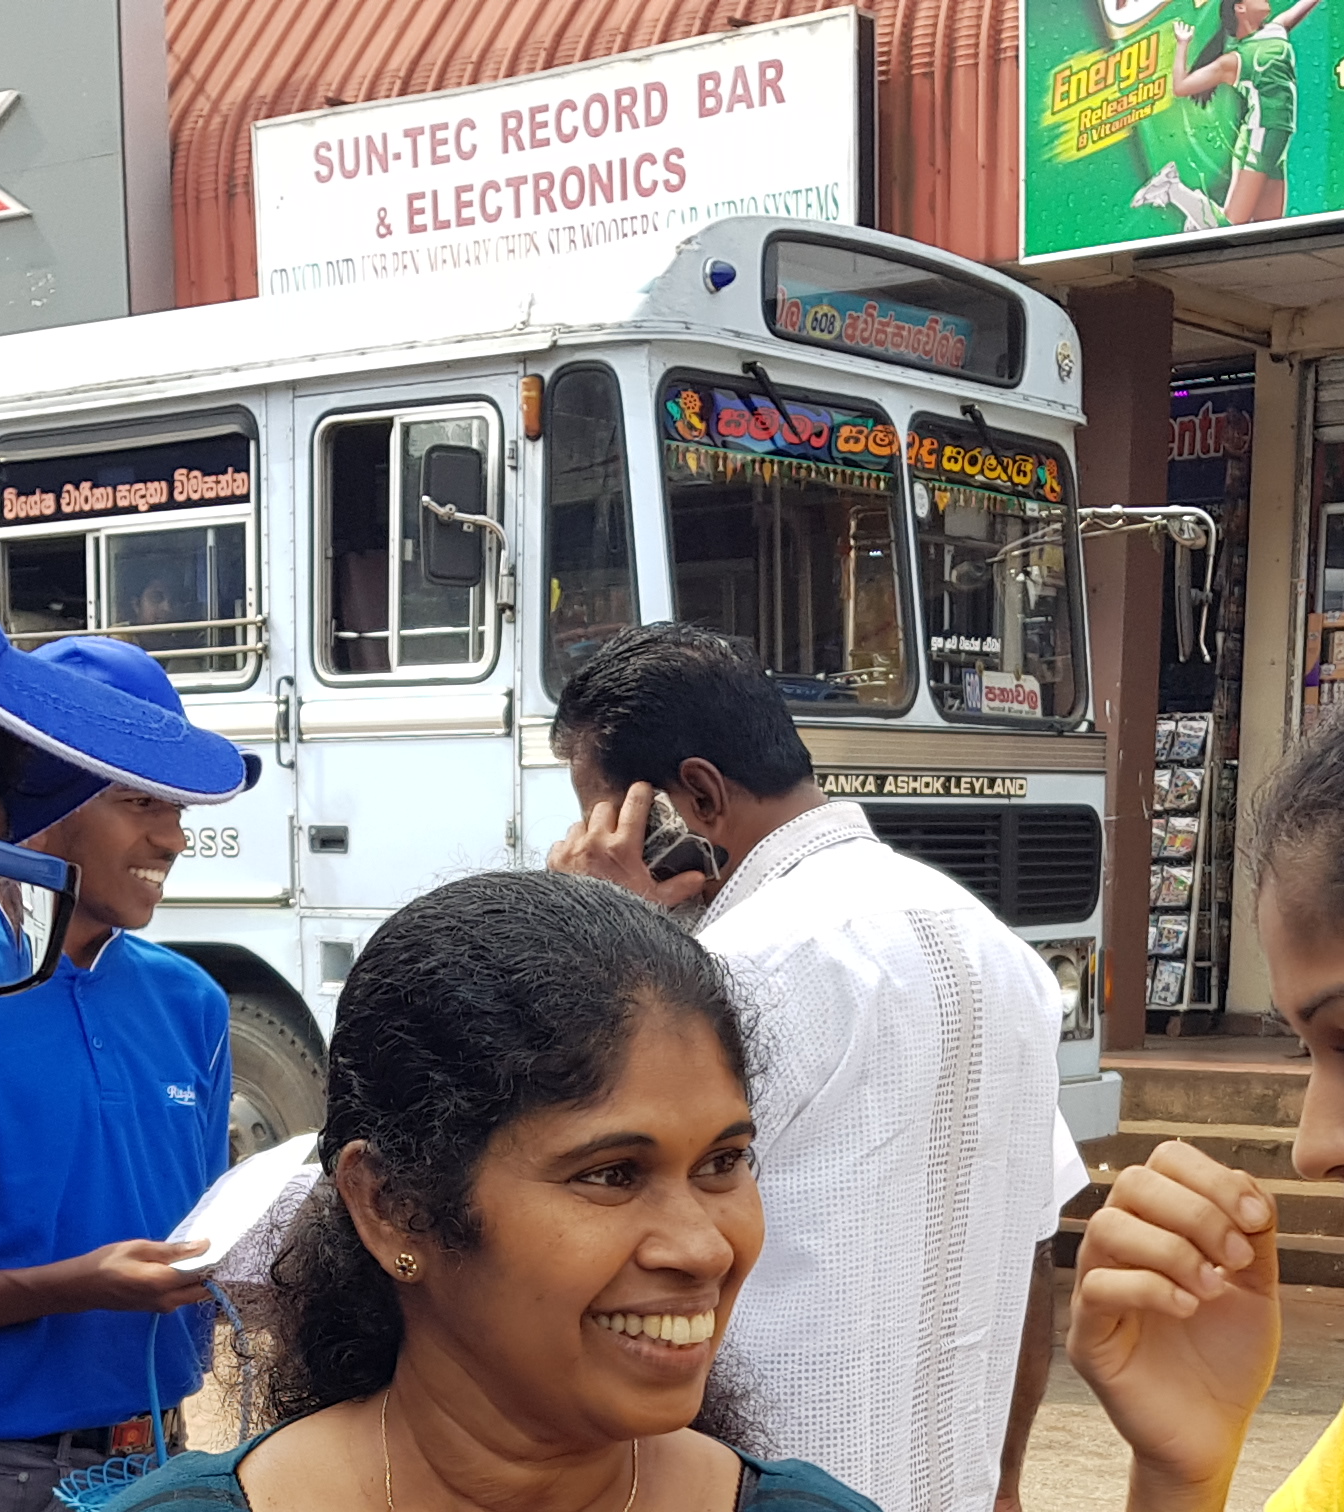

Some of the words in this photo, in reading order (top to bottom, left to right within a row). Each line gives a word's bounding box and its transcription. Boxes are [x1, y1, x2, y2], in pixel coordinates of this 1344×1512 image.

[1051, 32, 1160, 115] Energy
[1079, 74, 1168, 131] Releasing
[313, 118, 478, 185] SUN-TEC
[500, 80, 669, 155] RECORD
[697, 58, 787, 119] BAR
[1091, 103, 1155, 143] Vitamins
[375, 205, 394, 239] &
[406, 147, 687, 235] ELECTRONICS
[270, 267, 290, 296] CD
[326, 258, 356, 287] DVD
[762, 182, 840, 221] SYSTEMS
[810, 308, 836, 331] 608
[883, 776, 945, 795] ASHOK
[950, 777, 1028, 796] LEYLAND
